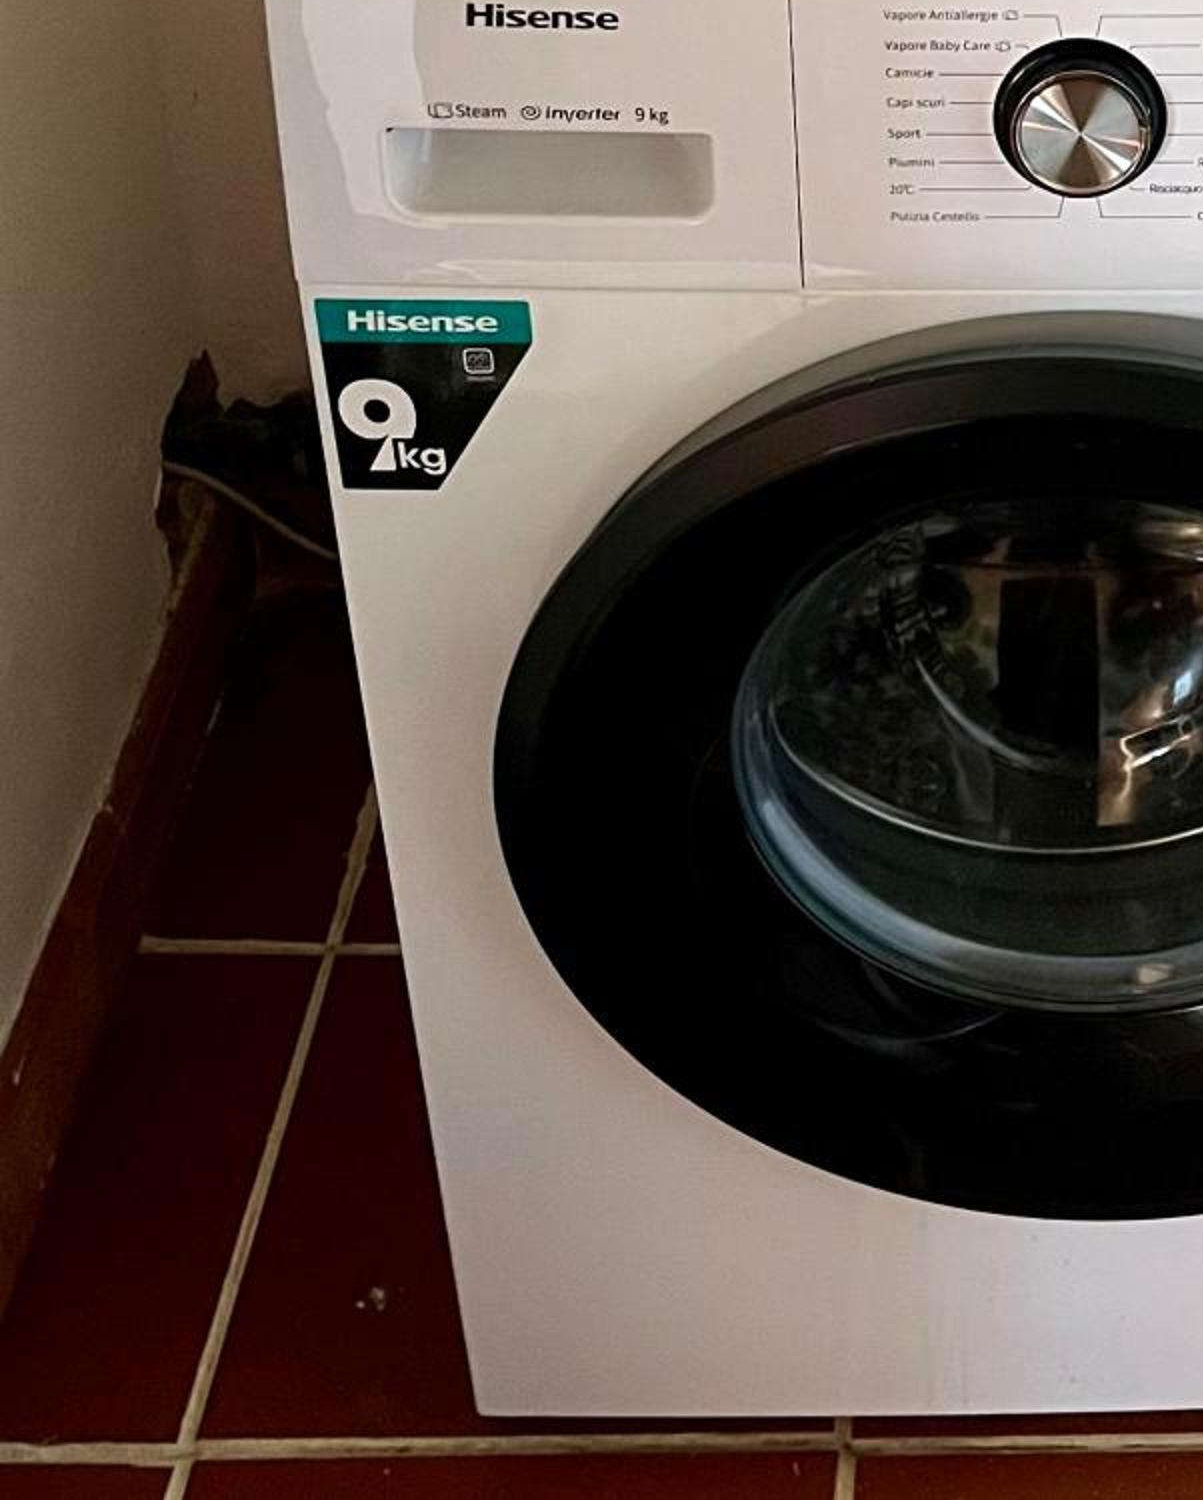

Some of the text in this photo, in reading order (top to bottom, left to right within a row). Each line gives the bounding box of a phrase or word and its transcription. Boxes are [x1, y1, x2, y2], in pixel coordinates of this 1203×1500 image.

[465, 3, 620, 30] Hisense
[883, 10, 927, 22] Vapore
[885, 40, 991, 52] Vapore Baby Care
[885, 67, 934, 79] Camicie
[886, 97, 945, 109] Capi scuri
[455, 104, 669, 125] Steam inverter 9 kg
[887, 128, 922, 140] Sport
[347, 309, 499, 333] Hisense
[397, 441, 447, 476] kg
